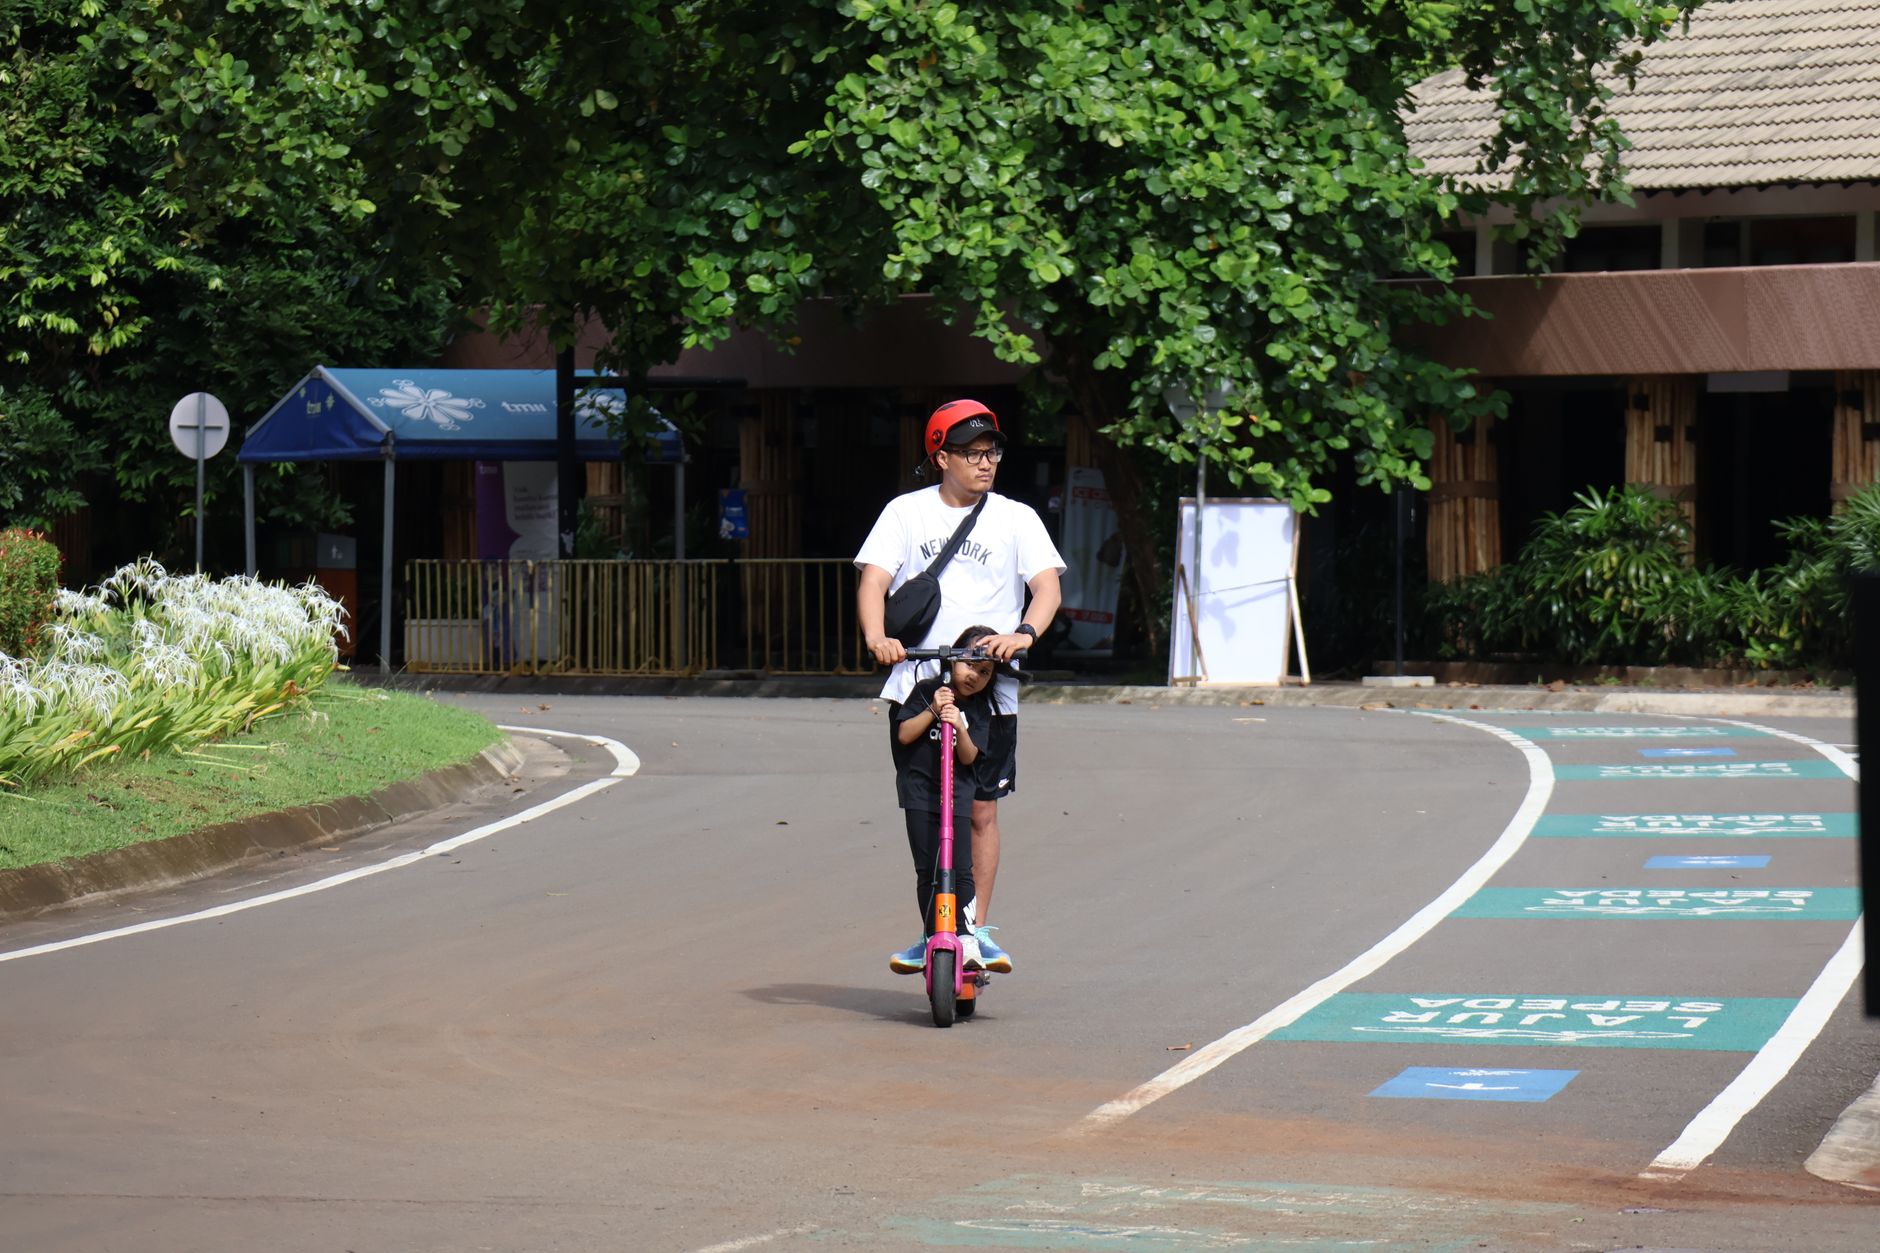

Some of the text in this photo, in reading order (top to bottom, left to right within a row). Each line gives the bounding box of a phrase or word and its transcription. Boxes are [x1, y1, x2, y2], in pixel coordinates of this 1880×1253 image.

[955, 540, 992, 565] ORK
[1410, 998, 1724, 1012] SEPEDA
[1380, 1011, 1710, 1029] LAJUR
